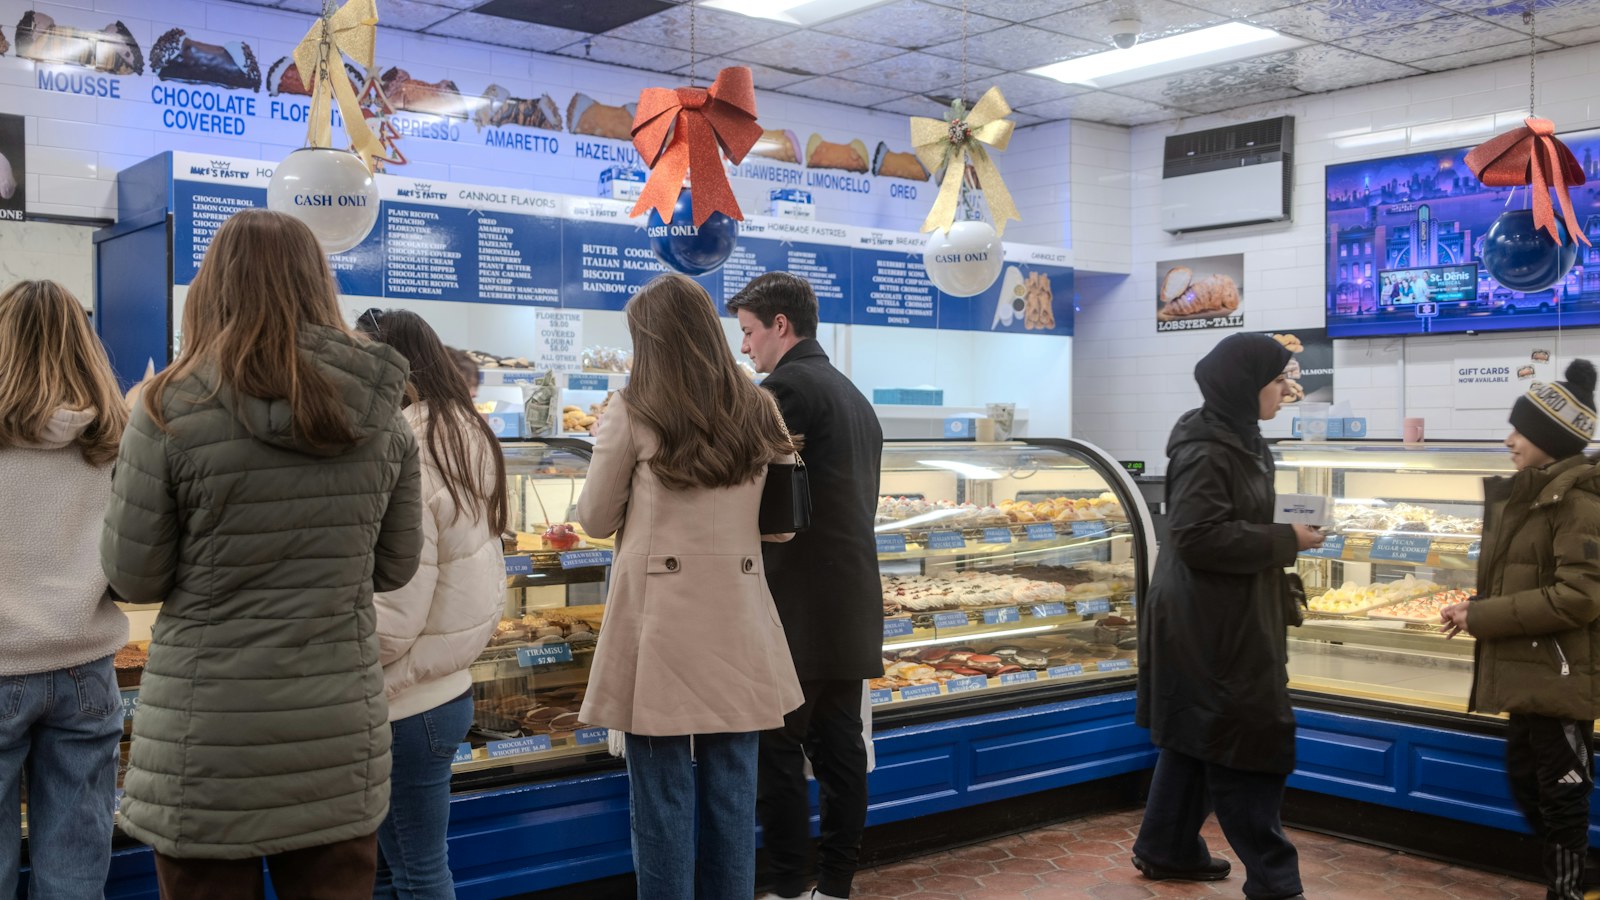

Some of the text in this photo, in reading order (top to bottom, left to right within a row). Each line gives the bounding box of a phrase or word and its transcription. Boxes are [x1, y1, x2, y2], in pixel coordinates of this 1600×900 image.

[38, 69, 121, 99] MOUSSE
[151, 86, 256, 116] CHOCOLATE
[163, 108, 246, 136] COVERED
[485, 129, 559, 154] AMARETTO
[220, 170, 249, 179] PASTRY
[731, 164, 803, 185] STRAWBERRY
[807, 172, 871, 194] LIMONCELLO
[422, 191, 448, 200] PASTRY
[890, 184, 917, 200] OREO
[192, 195, 236, 205] CHOCOLATE
[295, 194, 368, 208] CASH ONLY
[459, 190, 556, 209] CANNOLI FLAVORS
[193, 203, 219, 211] LEMON
[388, 209, 440, 220] PLAIN RICOTTA
[388, 217, 425, 226] PISTACHIO
[478, 218, 497, 226] OREO
[388, 225, 432, 233] FLORENTINE
[478, 226, 513, 235] AMARETTO
[648, 225, 700, 237] CASH ONLY
[768, 224, 846, 237] HOMEMADE PASTRIES
[478, 233, 508, 241] NUTELLA
[388, 240, 429, 249] CHOCOLATE
[478, 240, 513, 249] HAZELNUT
[582, 244, 618, 255] BUTTER
[388, 247, 461, 259] CHOCOLATE COVERED
[478, 248, 520, 257] LIMONCELLO
[935, 252, 989, 263] CASH ONLY
[388, 255, 454, 266] CHOCOLATE CREAM
[478, 255, 522, 264] STRAWBERRY
[582, 257, 620, 268] ITALIAN
[388, 263, 429, 272] CHOCOLATE
[478, 262, 531, 272] PEANUT BUTTER
[388, 270, 458, 281] CHOCOLATE MOUSSE
[478, 270, 532, 279] PECAN CARAMEL
[582, 270, 625, 281] BISCOTTI
[388, 278, 459, 289] CHOCOLATE RICOTTA
[478, 277, 496, 285] MINT
[388, 285, 442, 295] YELLOW CREAM
[478, 285, 558, 295] RASPBERRY MASCARPONE
[582, 282, 626, 293] RAINBOW
[478, 292, 559, 302] BLUEBERRY MASCARPONE
[536, 312, 580, 321] FLORENTINE
[541, 329, 575, 338] COVERED
[555, 354, 577, 362] OTHER
[1459, 367, 1510, 376] GIFT CARDS
[582, 731, 602, 739] BLACK
[497, 739, 534, 749] CHOCOLATE
[455, 753, 471, 761] $6.00
[492, 748, 521, 757] WHOOPIE
